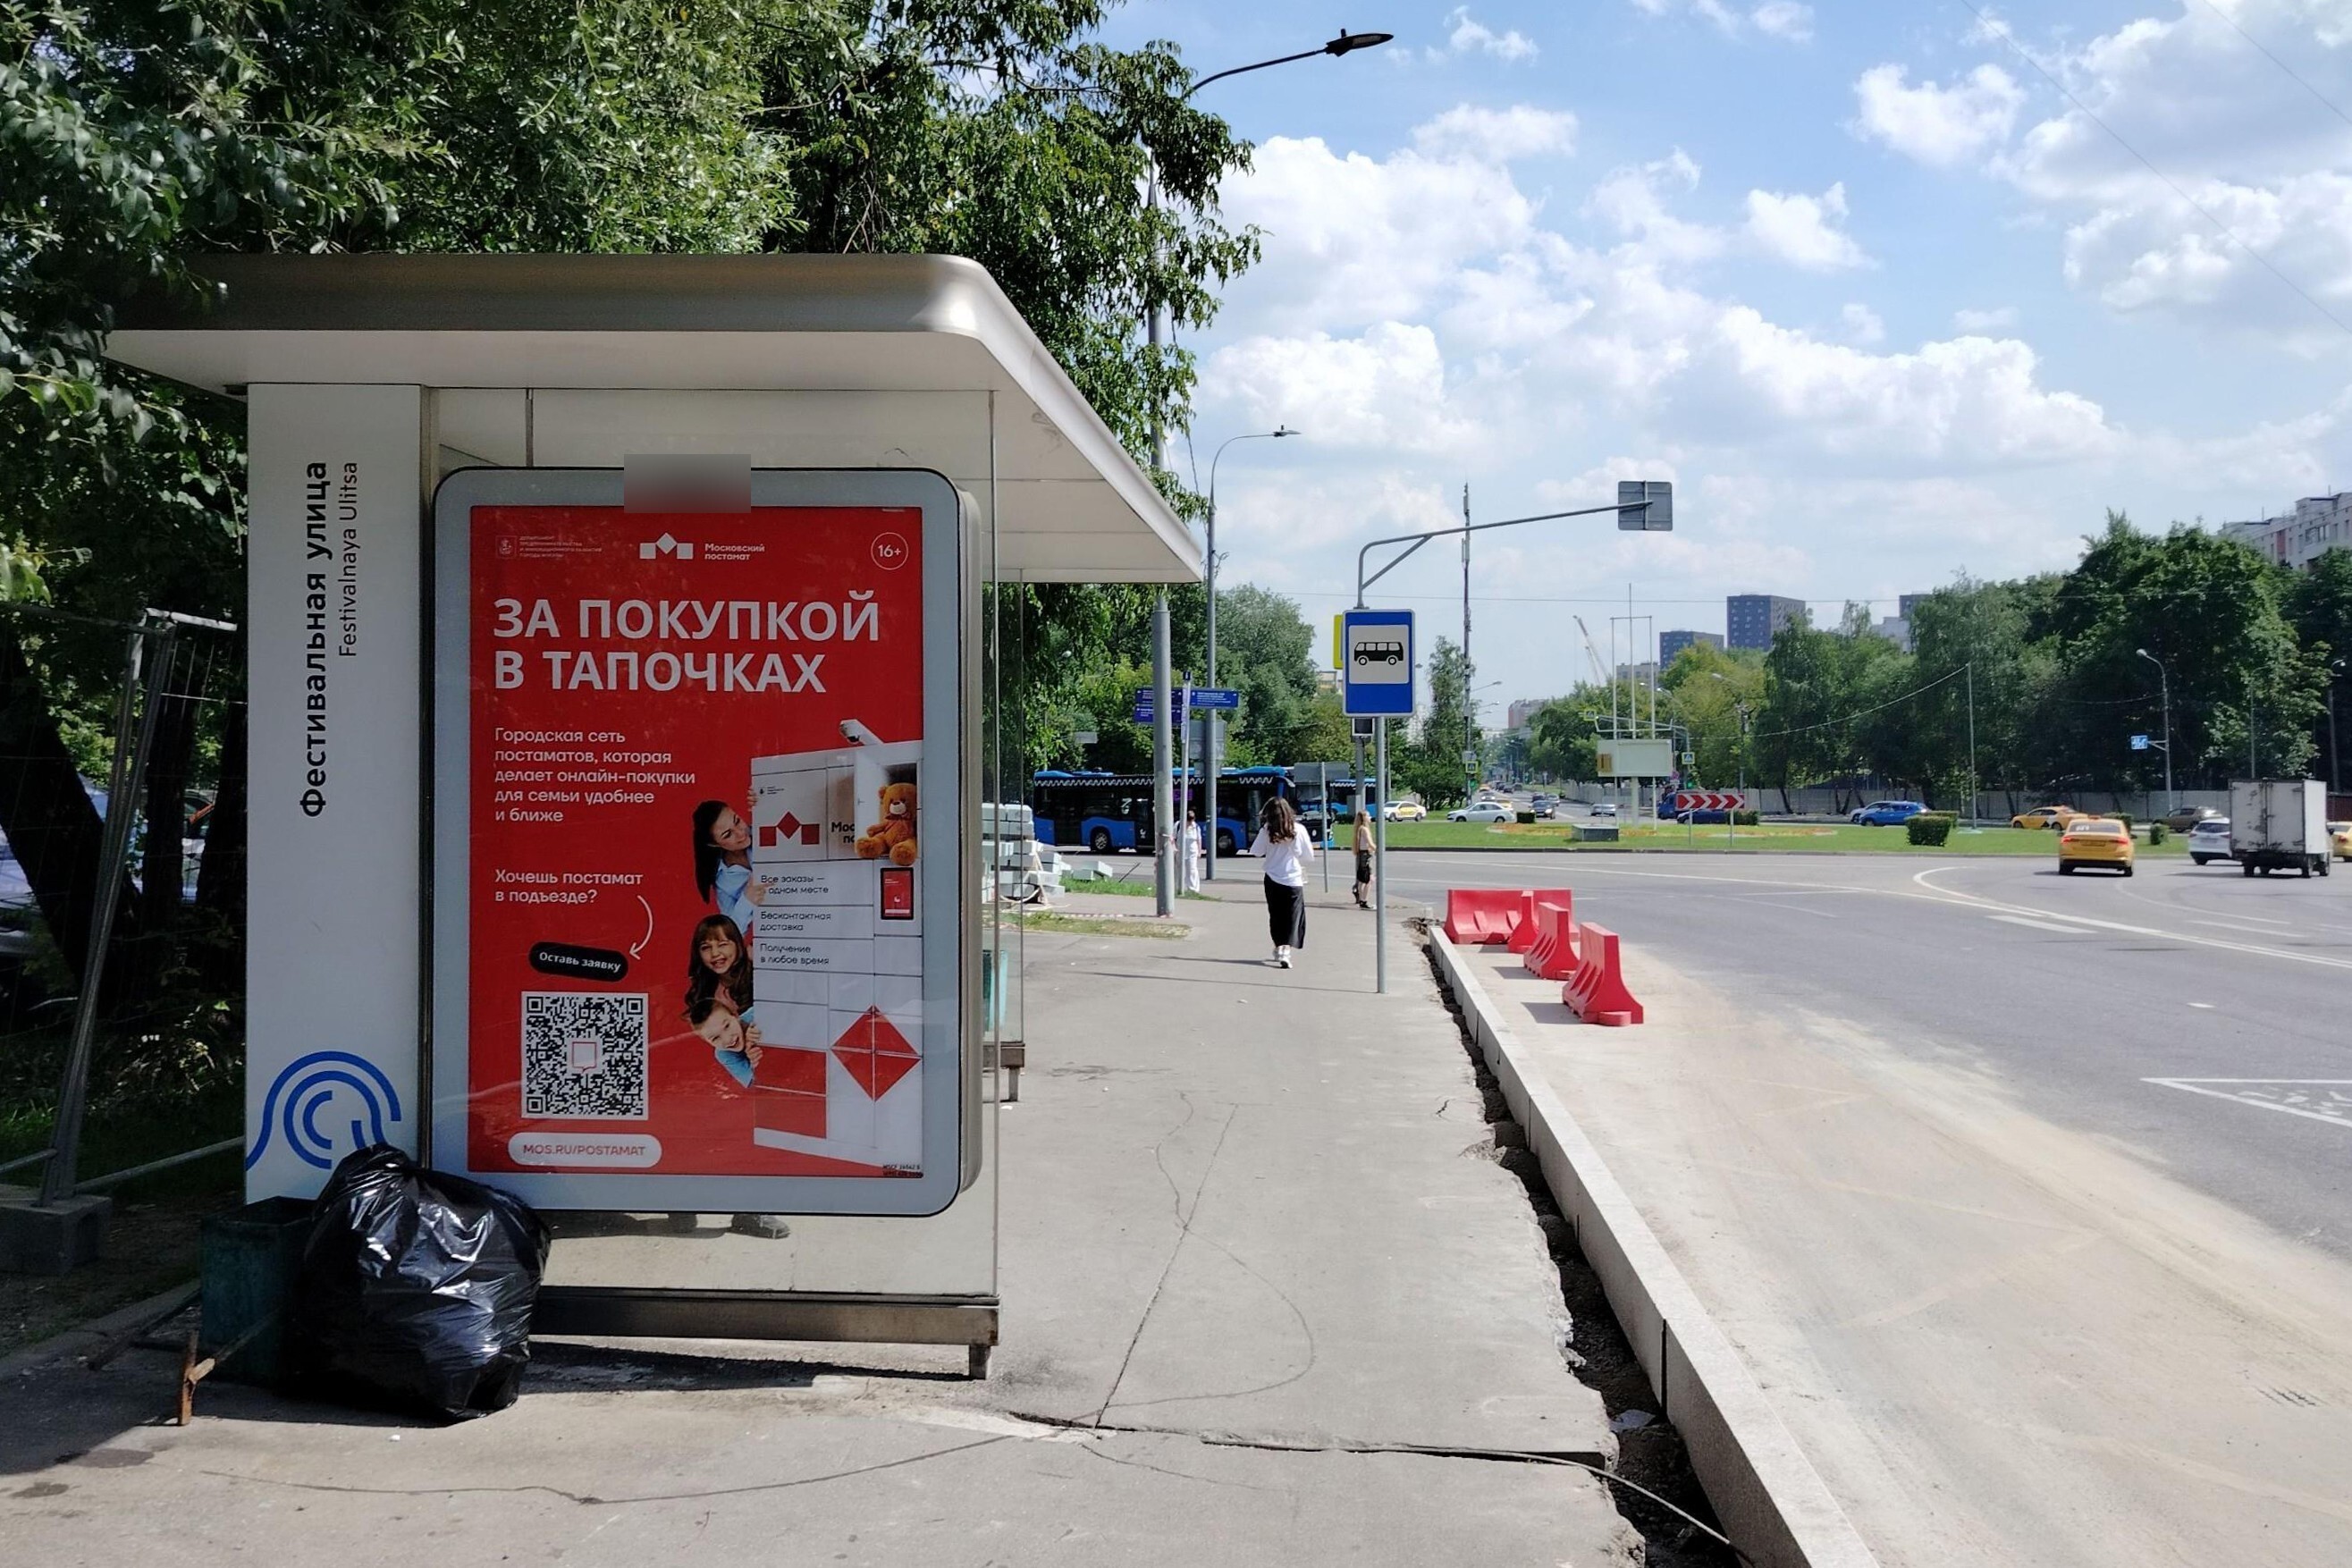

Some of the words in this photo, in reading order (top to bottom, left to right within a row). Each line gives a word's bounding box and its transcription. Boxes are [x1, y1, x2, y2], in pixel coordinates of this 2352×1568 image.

[338, 462, 358, 521] Ulitsa
[307, 462, 333, 560] улица
[704, 543, 765, 553] Московский
[878, 544, 902, 558] 16+
[338, 528, 360, 656] Festivalnaya
[493, 598, 561, 637] ЗА
[579, 589, 879, 642] ПОКУПКОЙ
[495, 650, 525, 689] В
[542, 651, 827, 693] ТАПОЧКАХ
[299, 573, 326, 817] Фестивальная
[495, 728, 583, 744] Городская
[588, 730, 626, 743] сеть
[495, 749, 598, 764] постаматов,
[603, 752, 672, 766] которая
[495, 770, 553, 783] делает
[557, 769, 695, 787] онлайн-покупки
[495, 789, 523, 803] для
[527, 790, 580, 803] семьи
[585, 789, 654, 805] удобнее
[495, 811, 505, 822] и
[510, 808, 564, 822] ближе
[831, 822, 856, 832] Мос
[495, 869, 558, 884] Хочешь
[562, 873, 644, 886] постамат
[761, 875, 779, 884] Все
[781, 875, 814, 884] заказы
[495, 890, 504, 901] в
[510, 889, 598, 905] подъезде?
[768, 887, 798, 895] одном
[760, 911, 831, 921] Бесконтактная
[759, 923, 804, 932] доставка
[760, 943, 812, 954] Получение
[539, 951, 579, 965] Оставь
[581, 957, 621, 974] заявку
[767, 956, 798, 965] любое
[800, 957, 830, 966] время
[523, 1144, 645, 1156] MOS.RU/POSTAMAT
